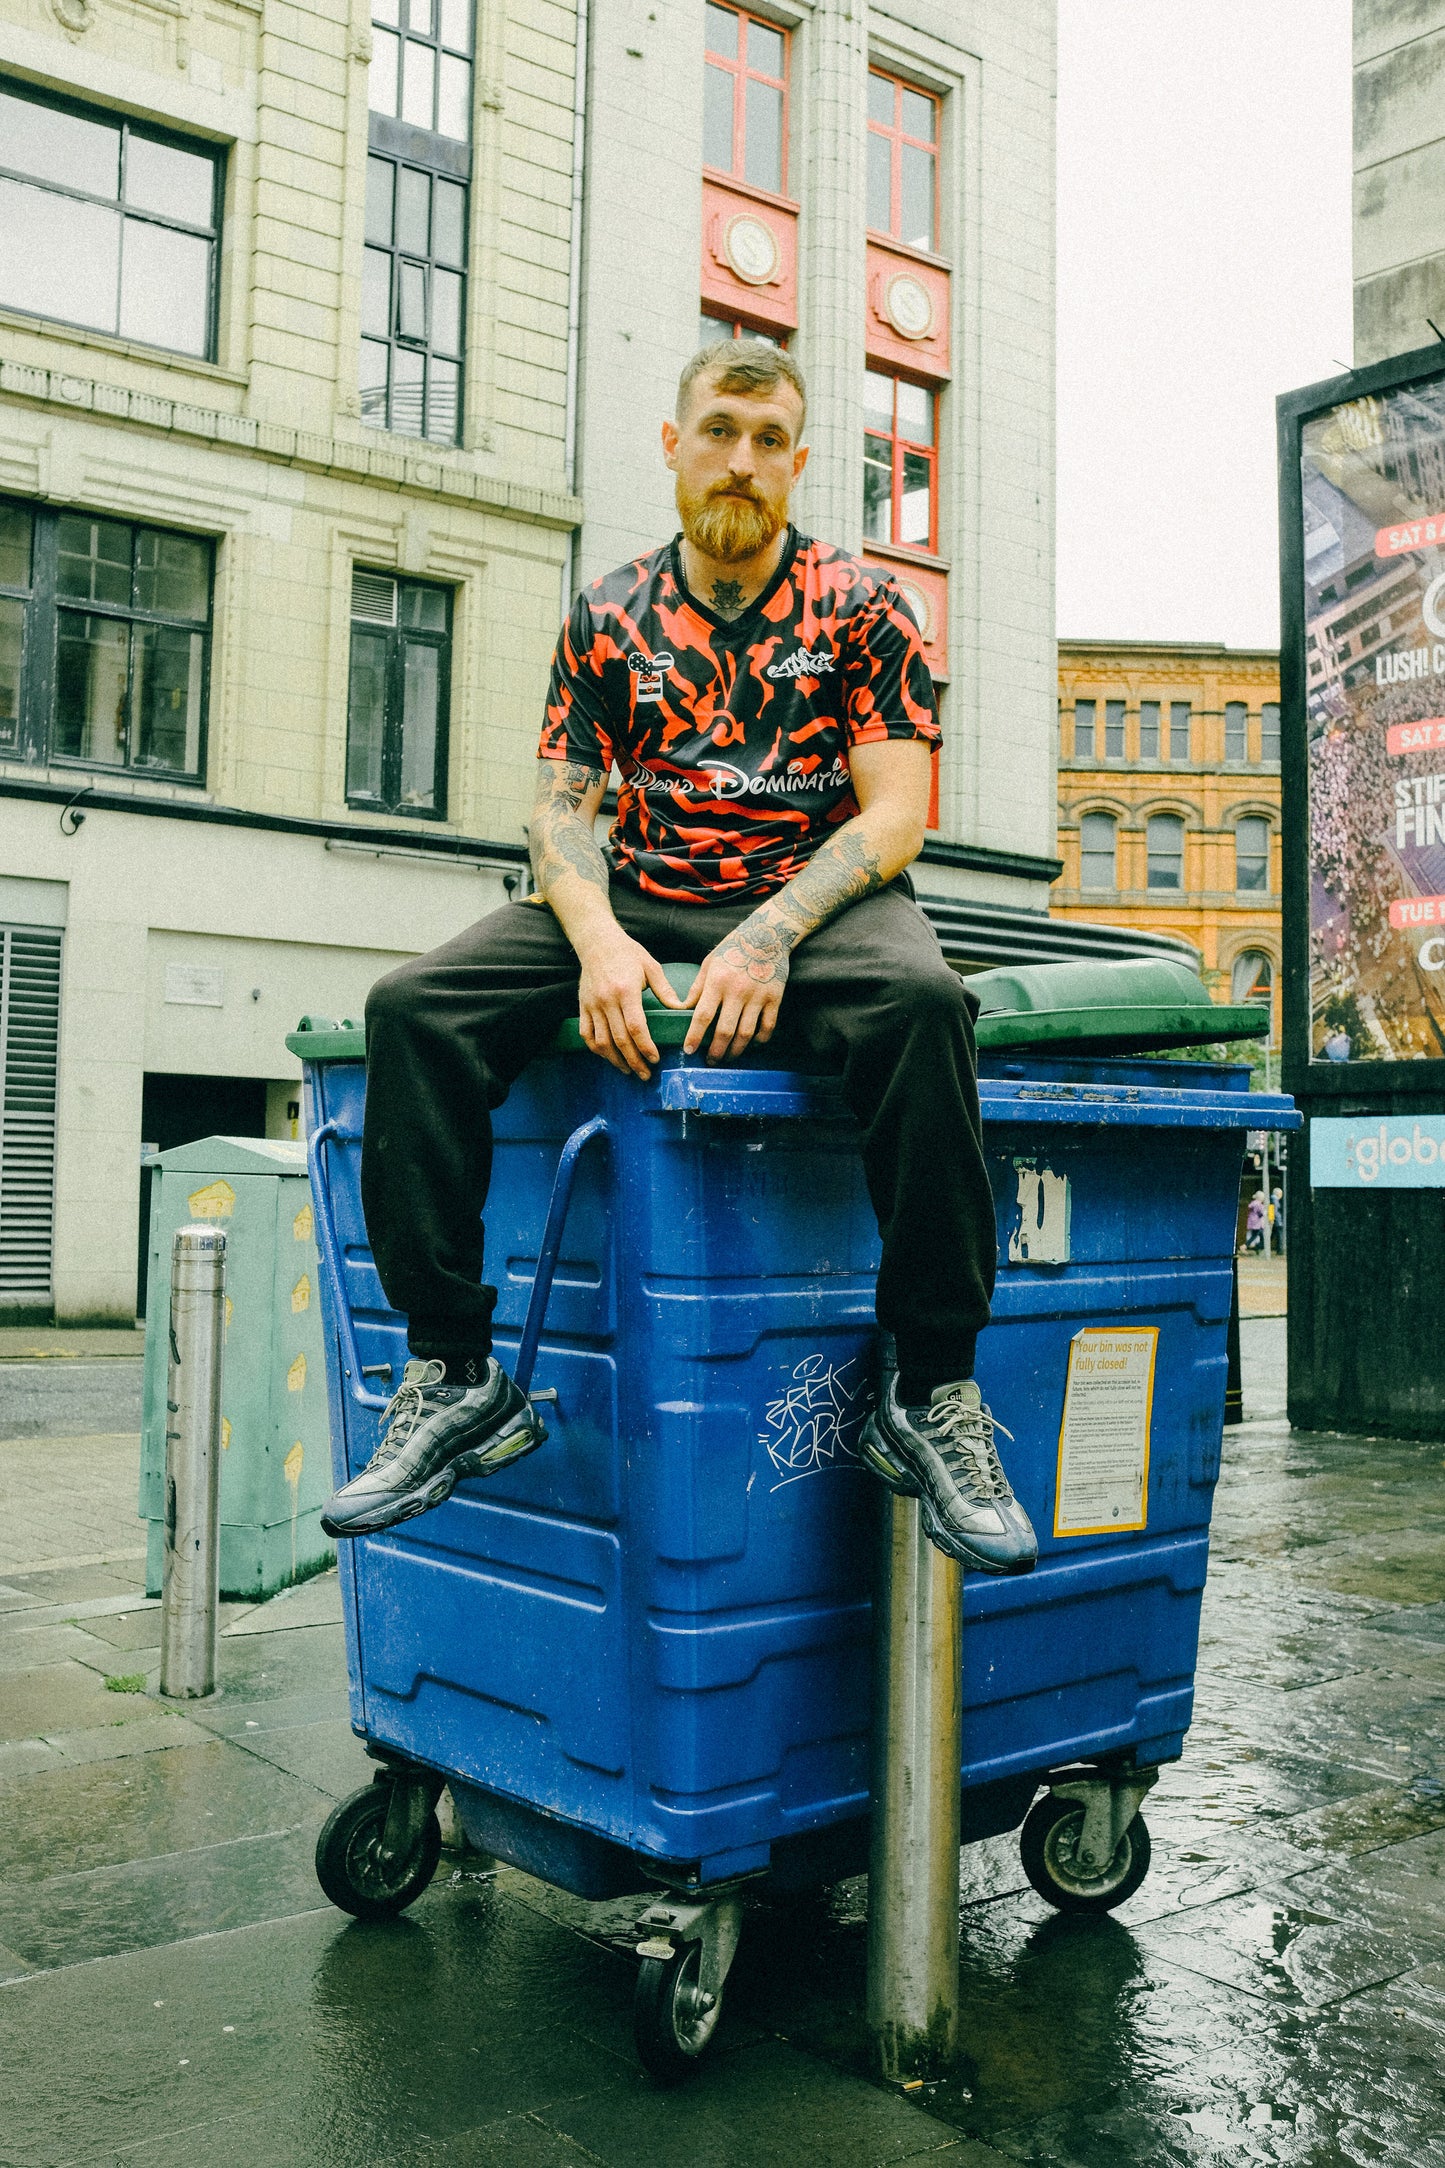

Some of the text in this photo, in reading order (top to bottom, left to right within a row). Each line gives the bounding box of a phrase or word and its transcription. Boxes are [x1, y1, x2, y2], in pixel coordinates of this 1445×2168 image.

[1389, 526, 1422, 550] SAT
[1426, 522, 1436, 541] 8
[1376, 647, 1428, 685] LUSH!
[1400, 725, 1433, 748] SAT
[1399, 902, 1435, 923] TUE
[1356, 1123, 1445, 1182] glob
[1078, 1340, 1148, 1353] Your bin was not
[1075, 1357, 1128, 1373] fully closed!
